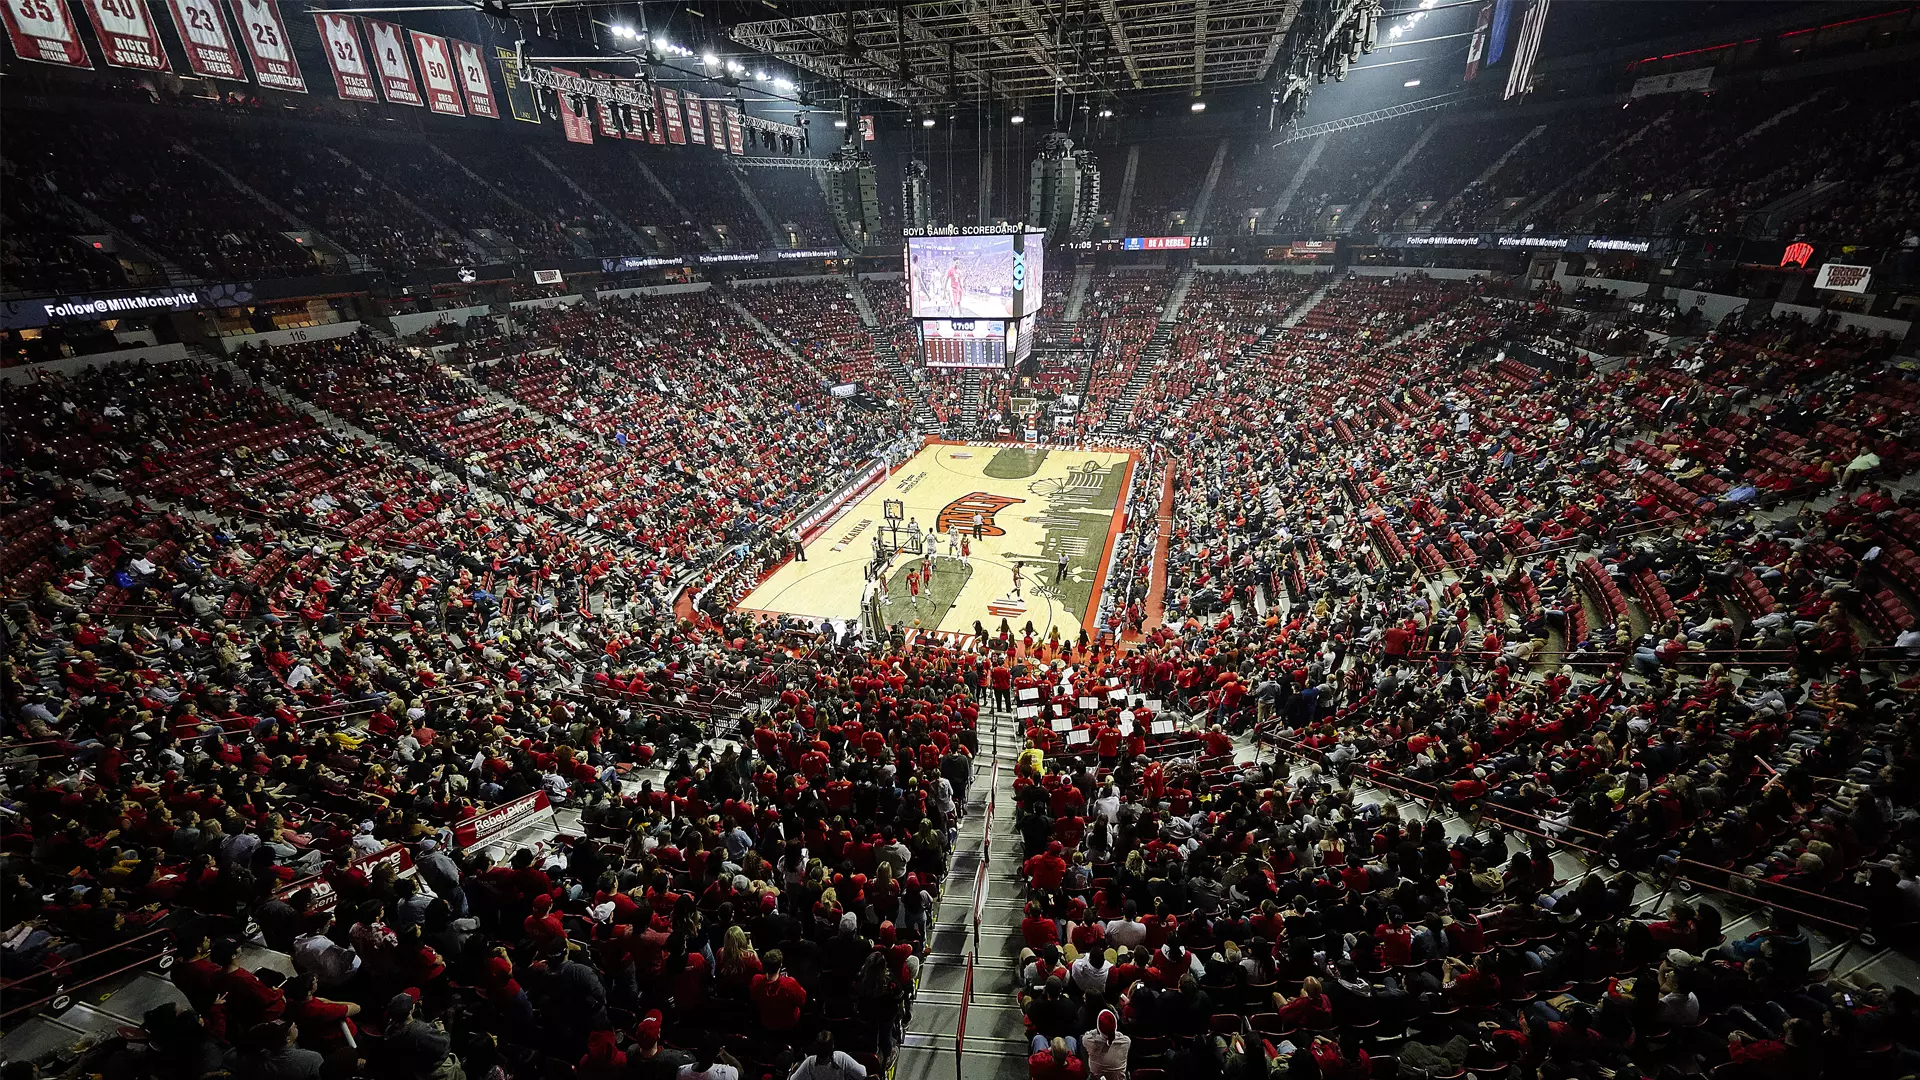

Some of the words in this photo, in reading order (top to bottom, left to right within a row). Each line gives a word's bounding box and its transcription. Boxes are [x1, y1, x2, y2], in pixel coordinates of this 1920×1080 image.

[20, 0, 54, 22] 35
[102, 0, 136, 20] 40
[186, 6, 215, 32] 23
[252, 23, 278, 46] 25
[37, 39, 65, 52] ARMON
[114, 38, 150, 54] RICKY
[334, 41, 356, 62] 32
[40, 50, 70, 63] GILLIAM
[114, 51, 160, 67] SOBERS
[197, 48, 230, 63] REGGIE
[387, 48, 396, 66] 4
[202, 60, 234, 74] THEUS
[268, 62, 288, 74] GLEN
[428, 61, 446, 80] 50
[342, 76, 368, 88] STACEY
[468, 66, 482, 84] 21
[346, 86, 374, 98] AUGMON
[389, 80, 409, 92] LARRY
[390, 89, 418, 102] JOHNSON
[438, 93, 452, 104] GREG
[435, 101, 460, 112] ANTHONY
[904, 228, 924, 236] BOYD
[927, 228, 959, 236] GAMING
[962, 225, 1018, 234] SCOREBOARD
[1070, 241, 1092, 249] 17:05
[1148, 239, 1156, 248] BE
[1158, 239, 1164, 247] A
[1780, 242, 1814, 268] UNLV
[1827, 266, 1869, 278] TERRIBLE
[1825, 276, 1862, 288] HERBST
[44, 292, 198, 317] Follow@MilkMoneyltd
[289, 329, 307, 342] 116
[830, 518, 872, 552] TRKANIAN
[474, 810, 506, 832] Rebel
[507, 798, 537, 818] Place
